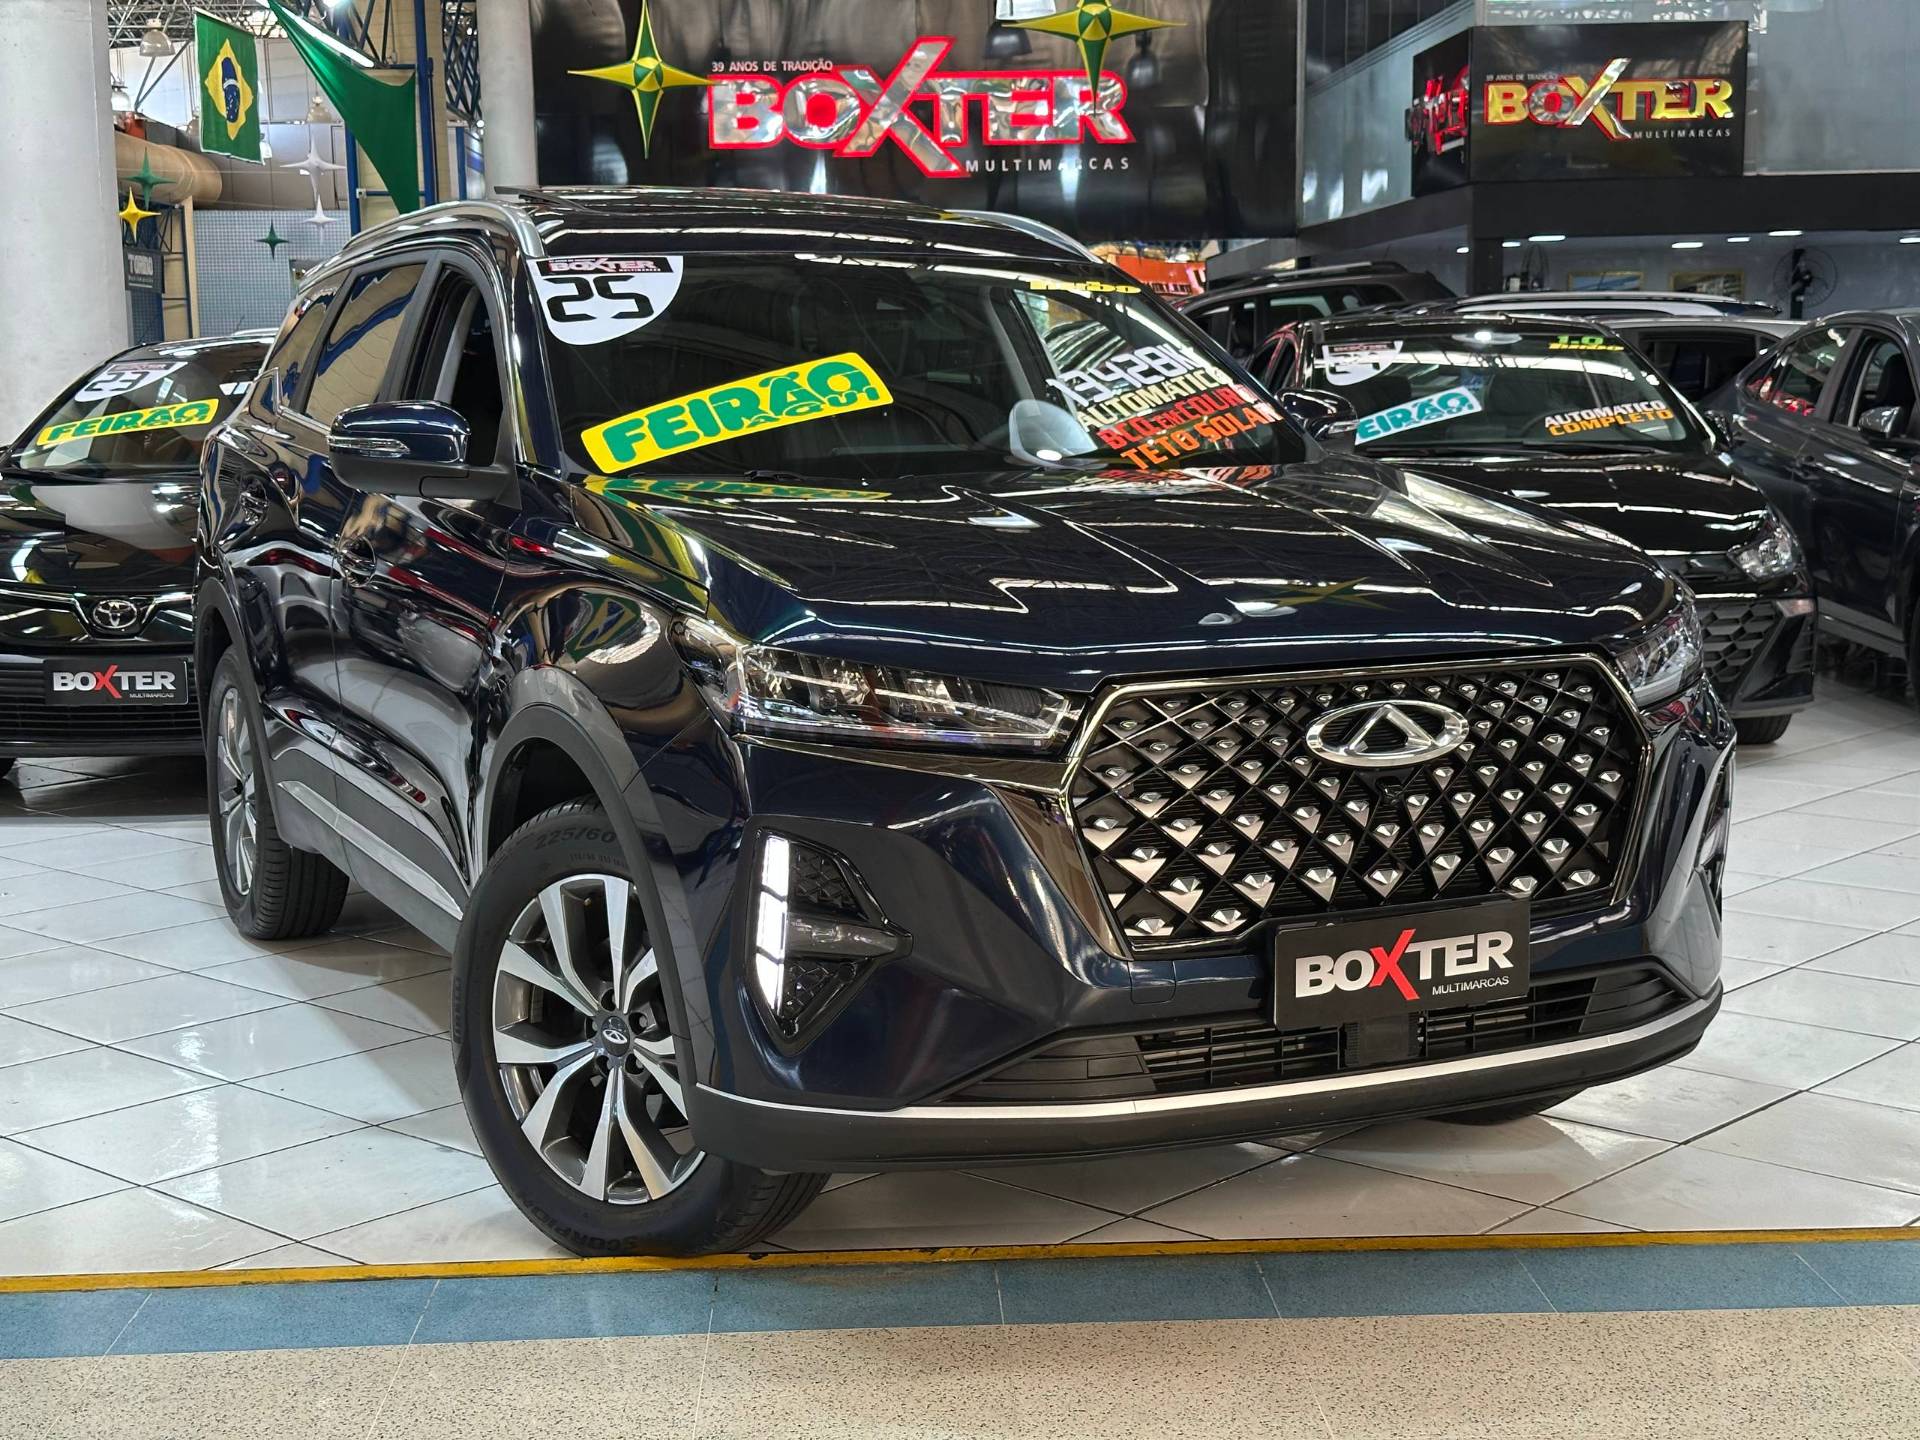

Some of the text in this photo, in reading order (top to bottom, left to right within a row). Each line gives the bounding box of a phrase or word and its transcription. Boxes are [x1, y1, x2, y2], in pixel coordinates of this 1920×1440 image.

[711, 59, 833, 73] 39 ANOS DE TRADIÇÃO
[707, 37, 1137, 178] BOXTER
[1484, 57, 1735, 140] BOXTER
[1633, 128, 1731, 139] MULTIMARCAS
[548, 257, 657, 273] BOXTER
[542, 274, 655, 323] 25
[84, 371, 150, 392] 23
[602, 361, 872, 464] FEIRÃO
[1549, 408, 1675, 437] COMPLETO
[1120, 429, 1200, 471] TETO
[52, 664, 177, 699] BOXTER
[1295, 928, 1515, 1001] BOXTER
[1431, 974, 1511, 996] MULTIMARCAS
